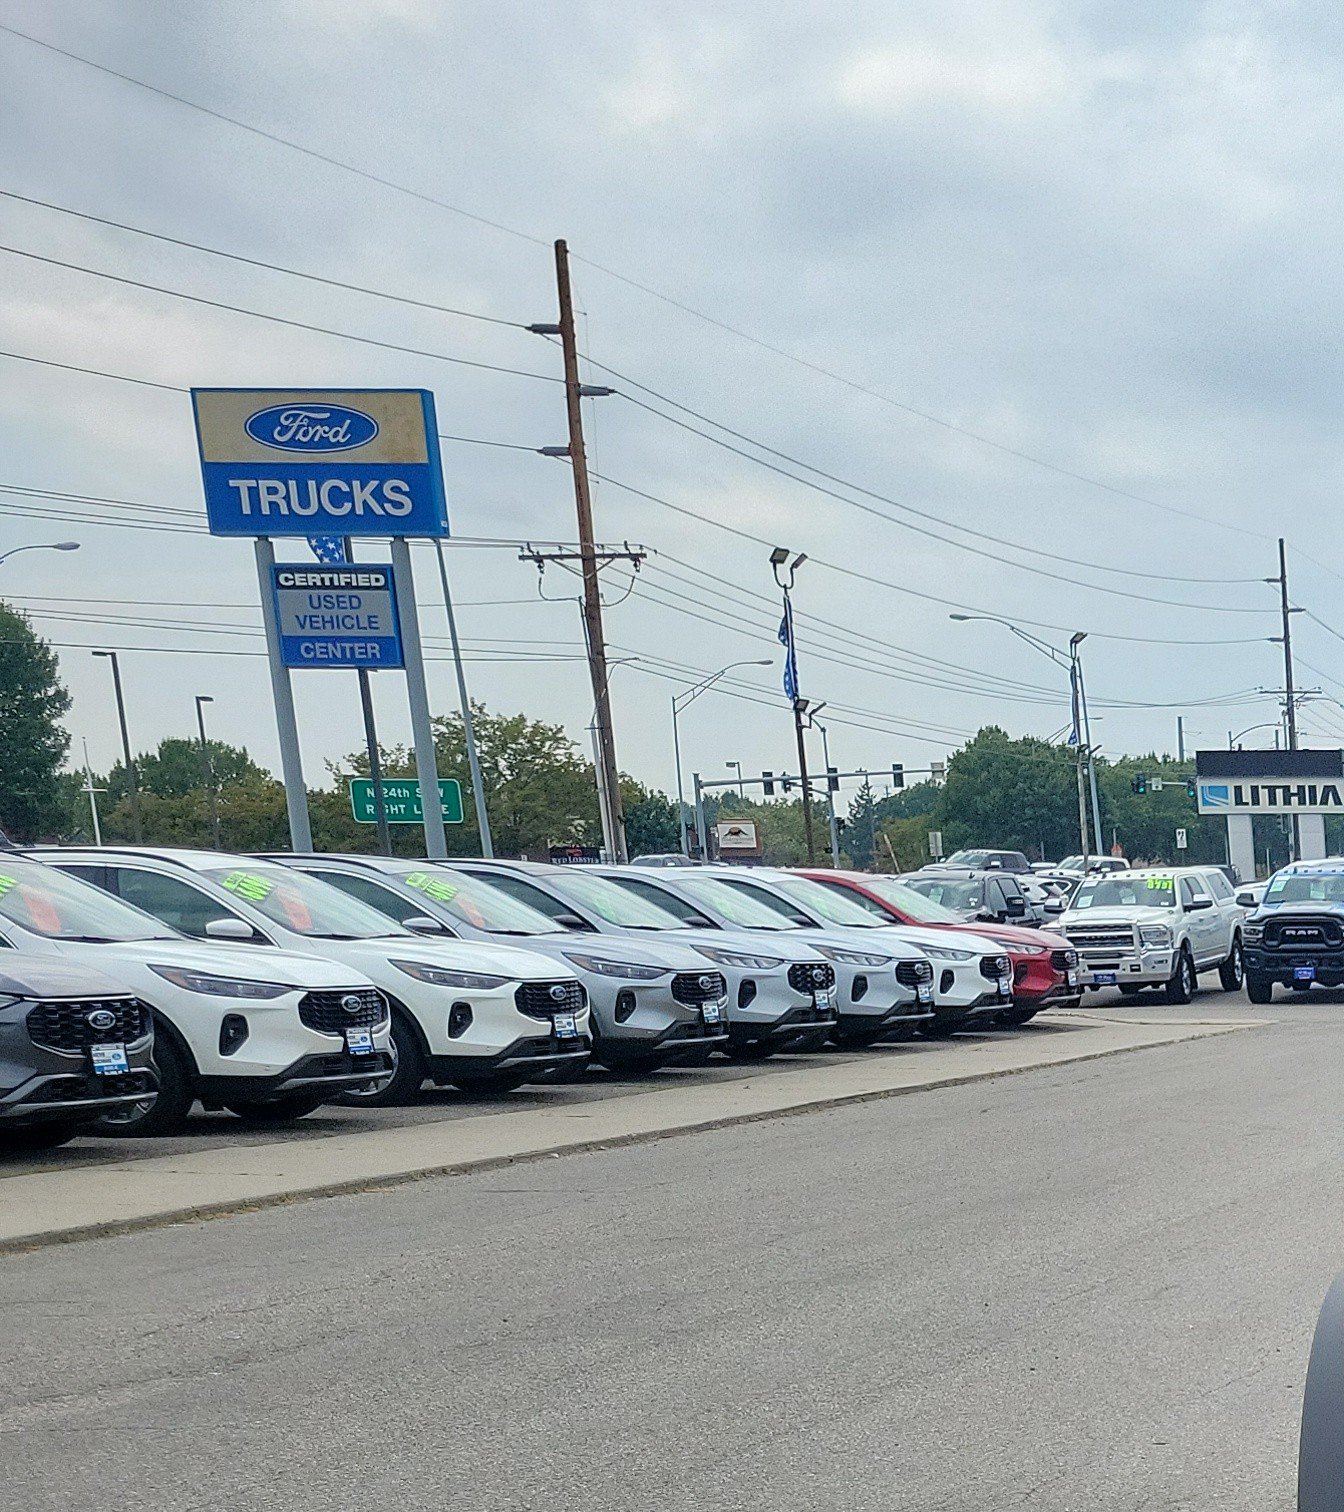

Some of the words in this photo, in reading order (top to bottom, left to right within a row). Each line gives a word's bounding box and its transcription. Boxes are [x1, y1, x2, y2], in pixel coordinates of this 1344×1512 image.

[273, 410, 352, 443] Ford
[228, 478, 413, 517] TRUCKS
[278, 572, 386, 588] CERTIFIED
[308, 594, 362, 610] USED
[295, 614, 380, 631] VEHICLE
[300, 642, 381, 660] CENTER
[1233, 785, 1343, 807] LITHIA
[366, 804, 406, 815] RHT
[413, 804, 450, 815] LE
